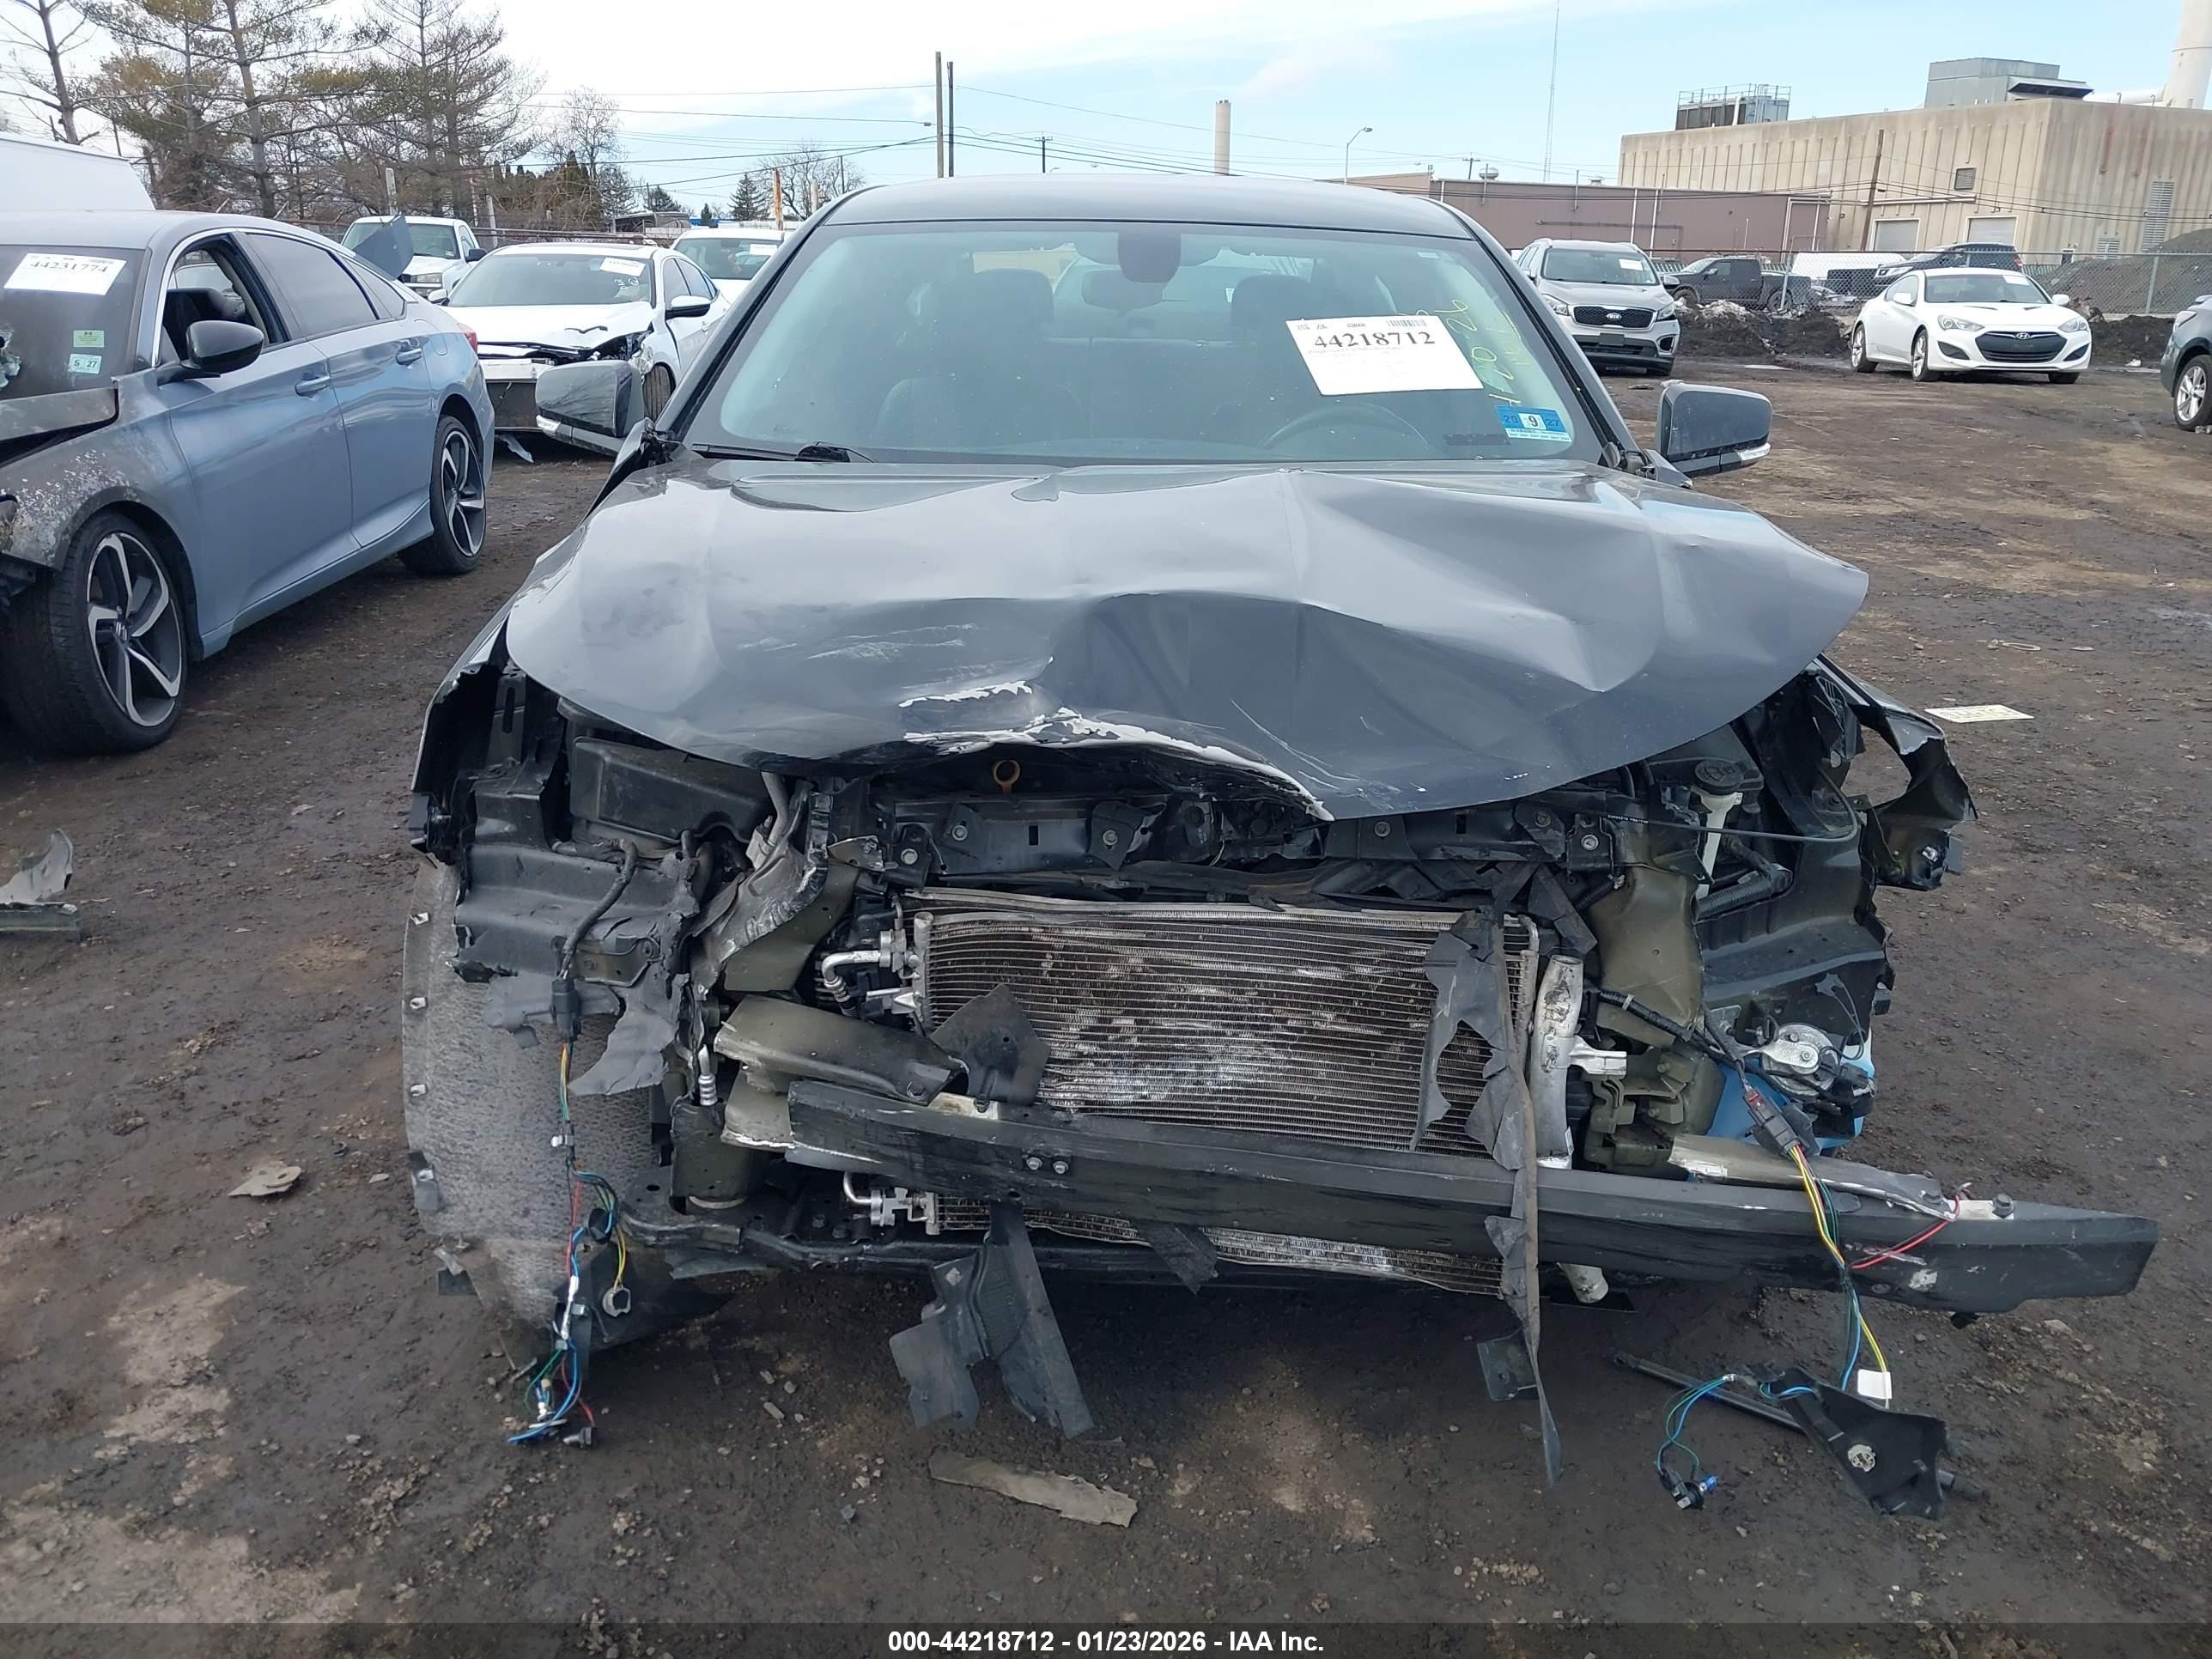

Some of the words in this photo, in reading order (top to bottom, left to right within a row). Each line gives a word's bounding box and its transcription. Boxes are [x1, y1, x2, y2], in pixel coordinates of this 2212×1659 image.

[30, 261, 108, 272] 44231774
[1314, 331, 1436, 347] 44218712
[1504, 415, 1519, 424] 20
[1528, 415, 1539, 428] 9
[1546, 418, 1559, 427] 27
